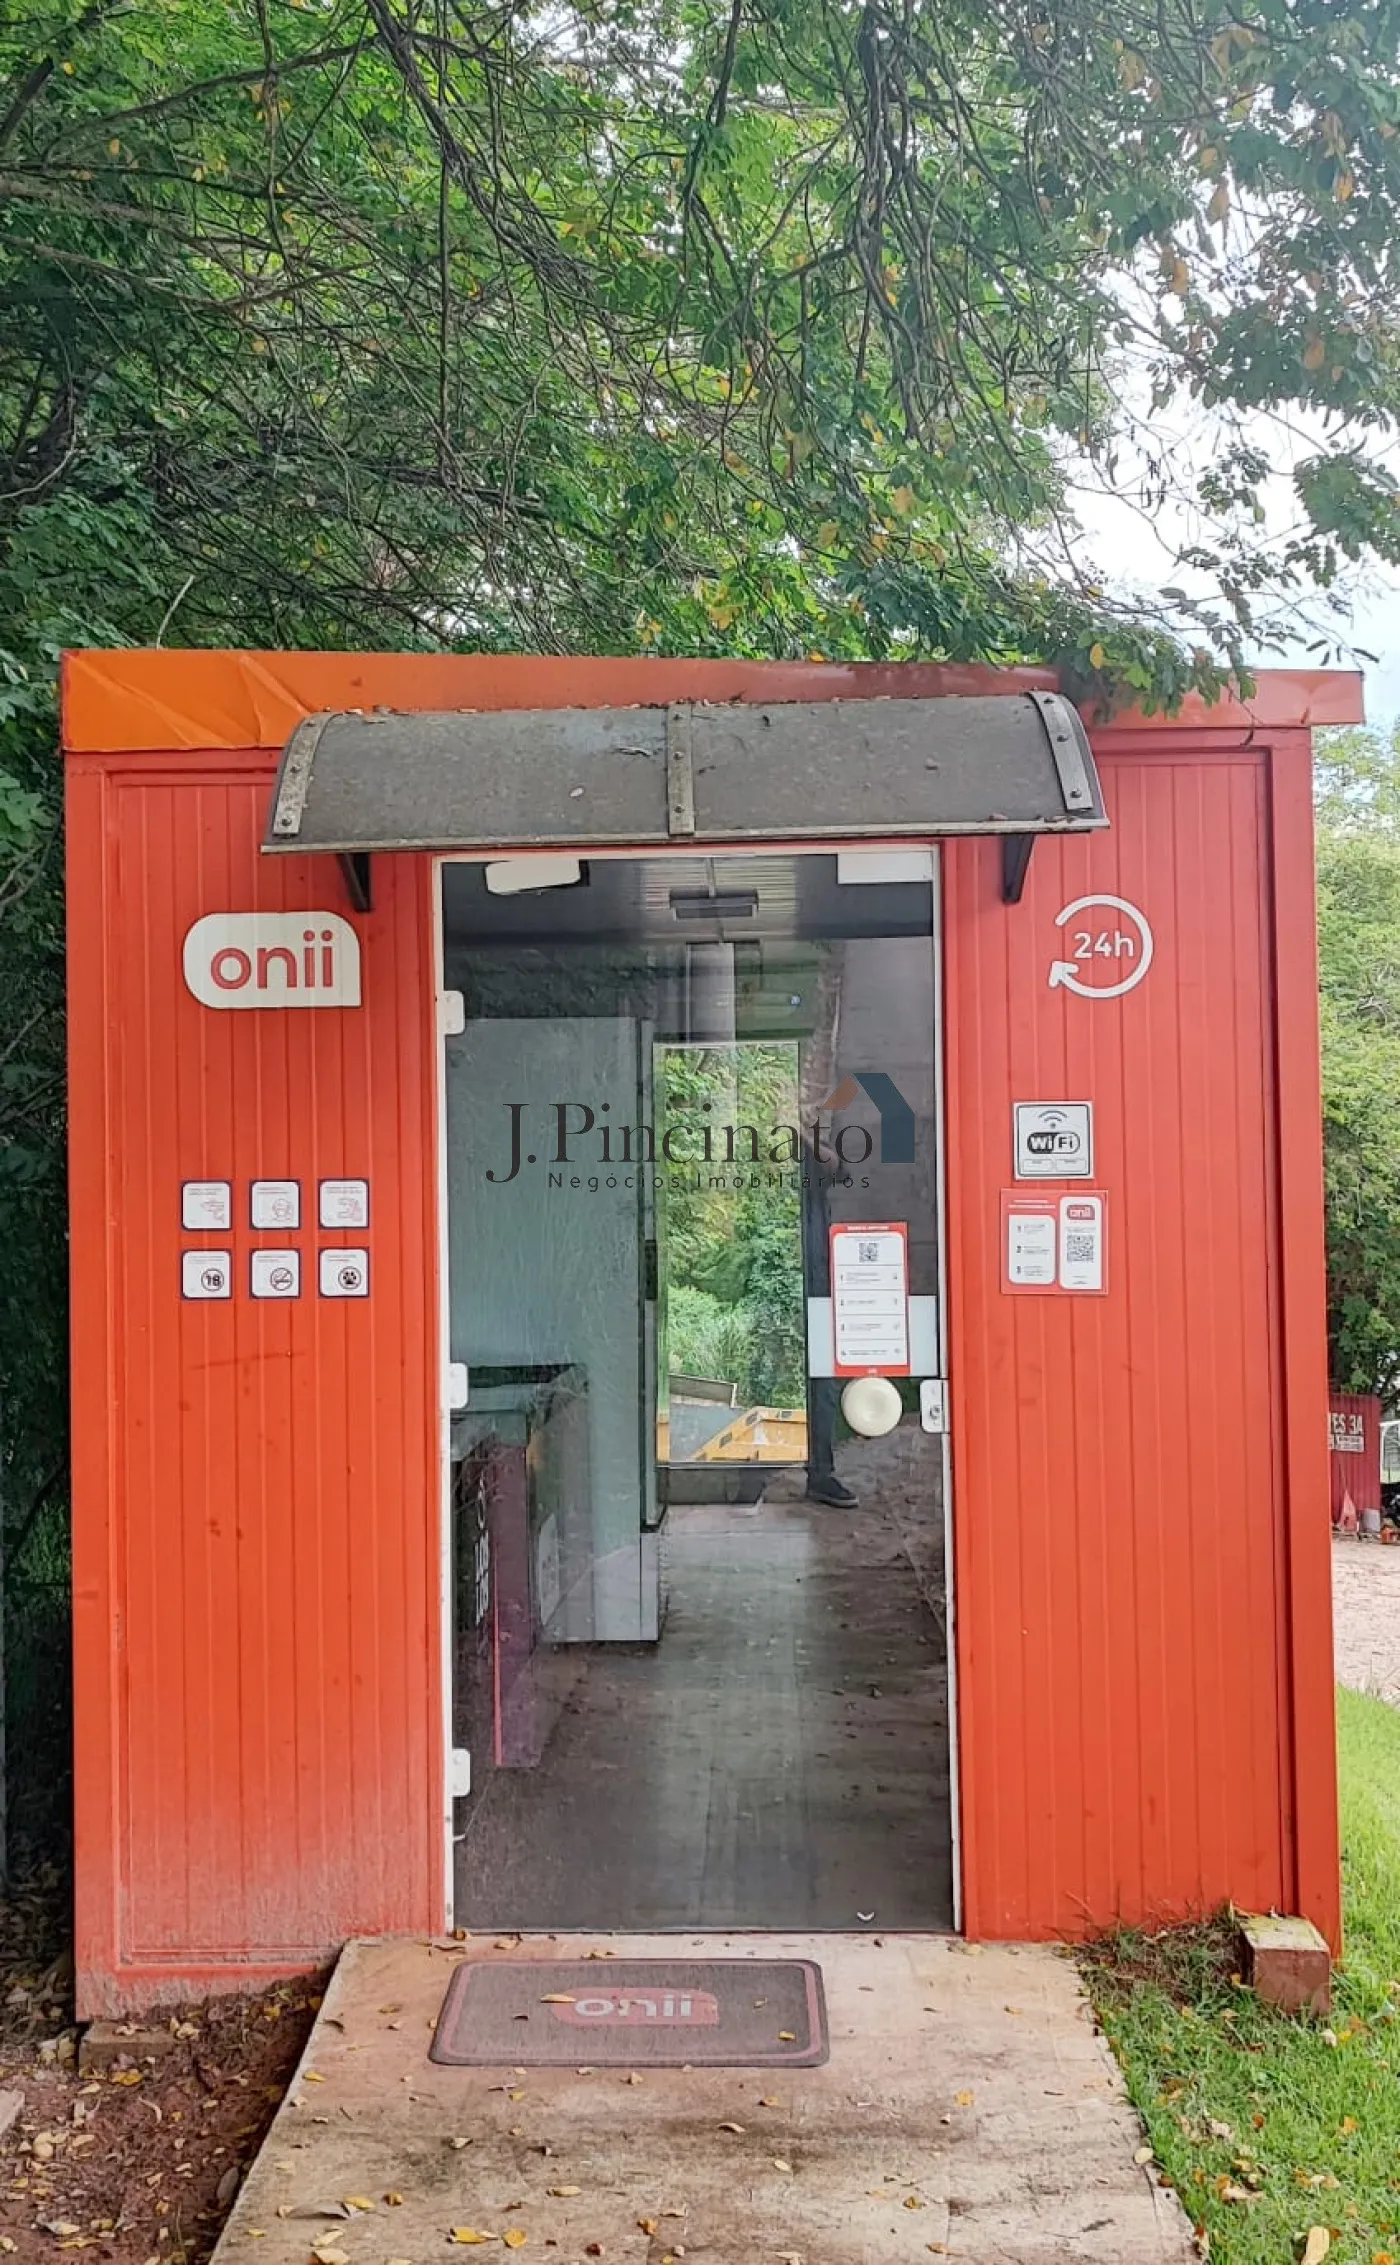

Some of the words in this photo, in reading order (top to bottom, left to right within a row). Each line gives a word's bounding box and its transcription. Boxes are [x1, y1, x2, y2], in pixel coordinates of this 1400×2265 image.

[1073, 930, 1135, 959] 24h
[210, 929, 334, 990] onii
[205, 1274, 221, 1287] 18
[574, 1994, 693, 2017] onii
